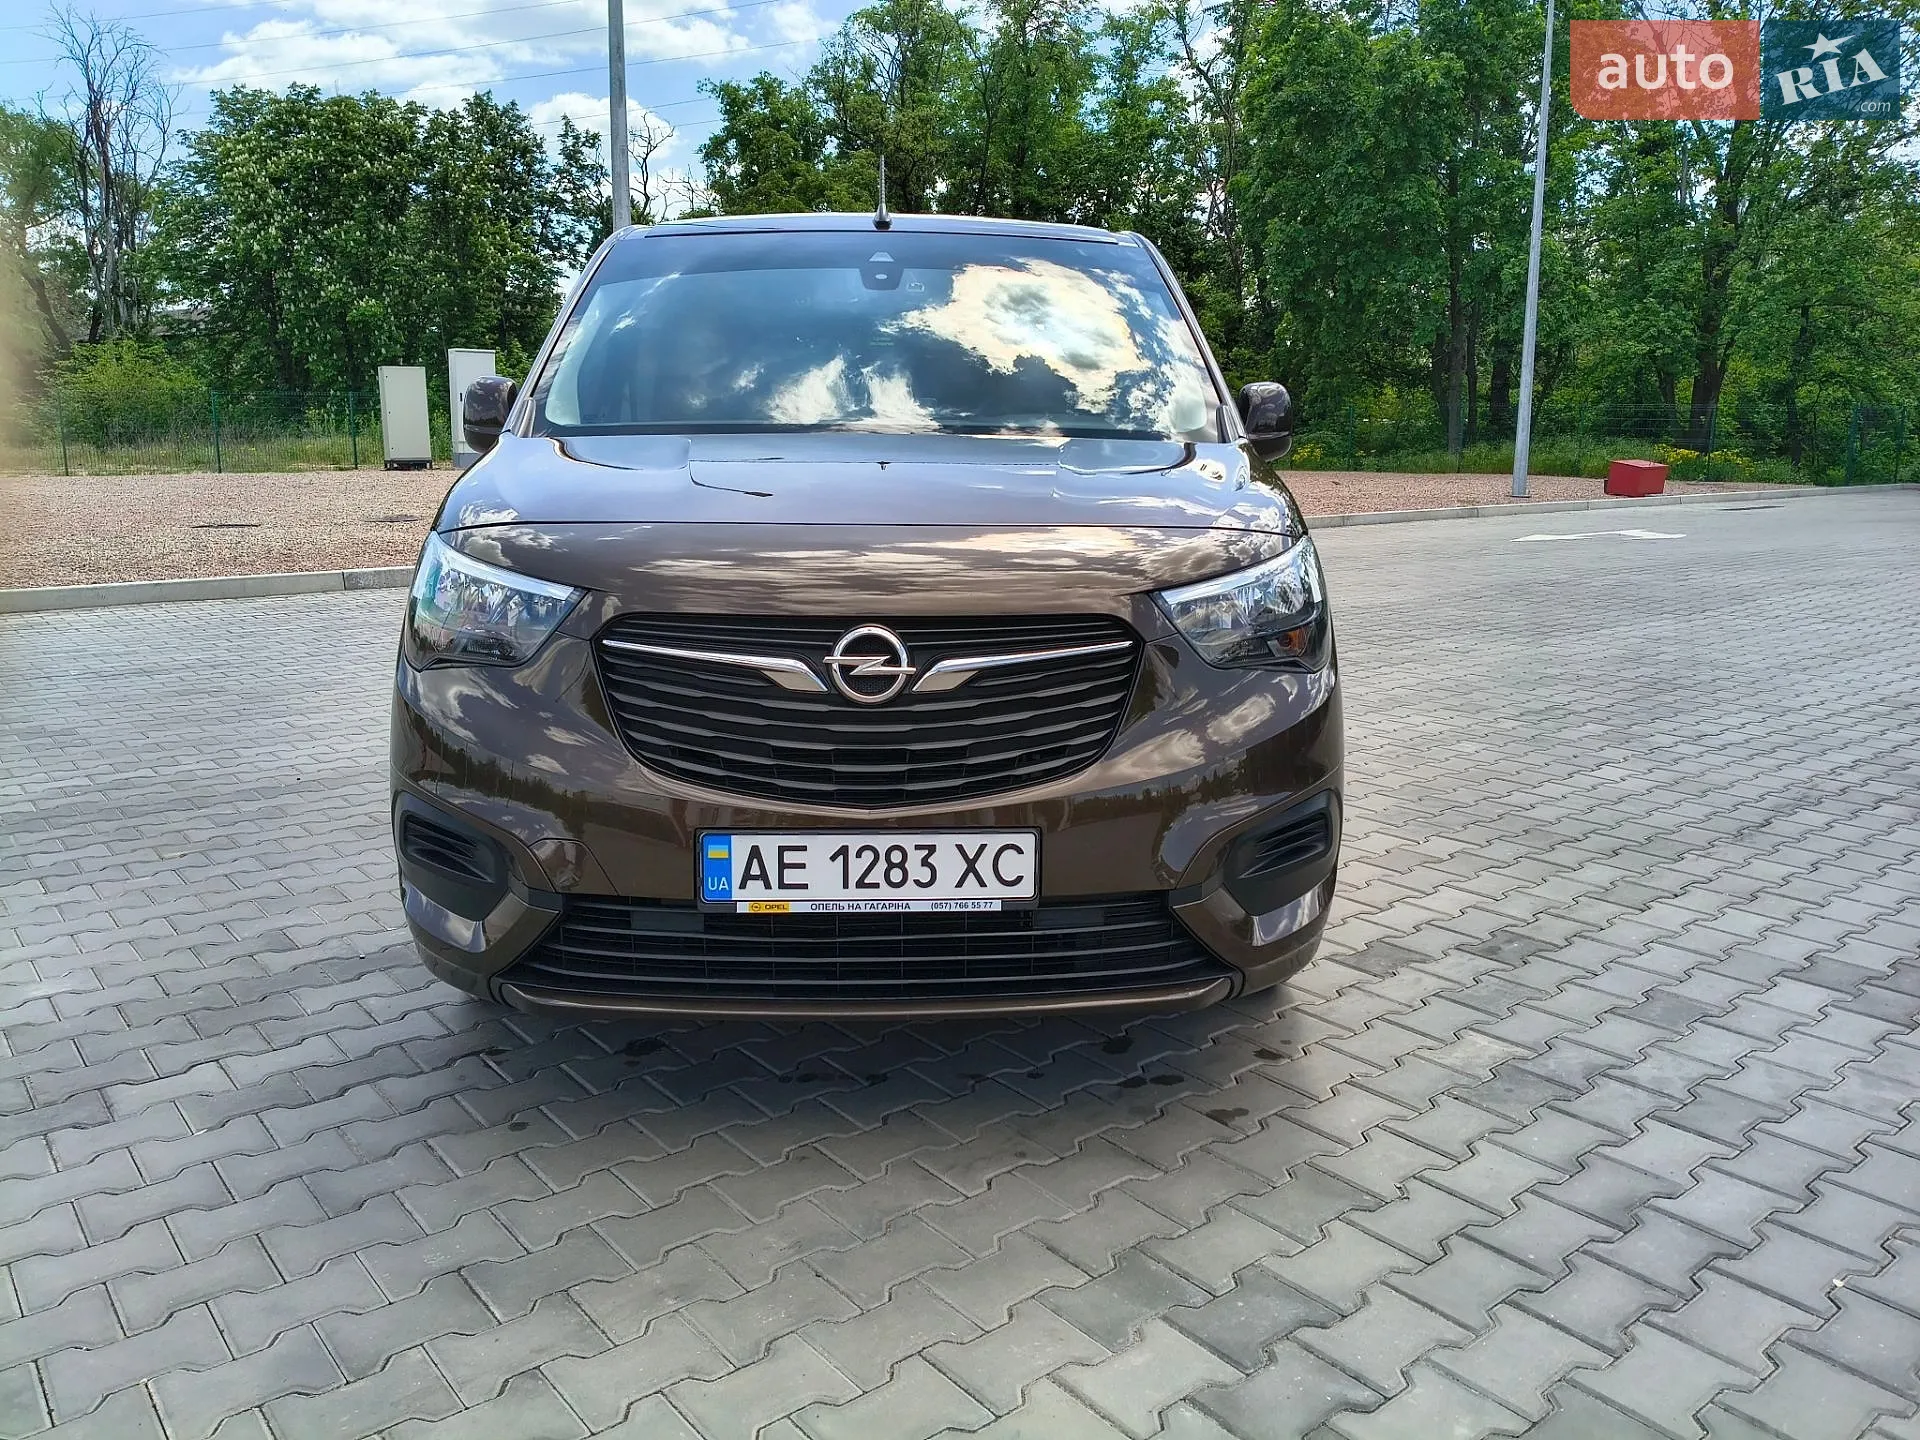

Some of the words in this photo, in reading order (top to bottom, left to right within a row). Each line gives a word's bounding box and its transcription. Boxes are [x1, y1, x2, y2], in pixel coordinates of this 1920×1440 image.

[738, 844, 809, 890] AE
[829, 844, 937, 889] 1283
[954, 843, 1025, 888] XC
[708, 876, 729, 891] UA
[810, 903, 845, 911] ОПЕЛЬ
[847, 903, 862, 911] НА
[864, 902, 911, 911] ГАГАРІНА
[930, 901, 952, 911] (057)
[954, 901, 969, 910] 766
[971, 901, 981, 910] 55
[983, 901, 994, 909] 77
